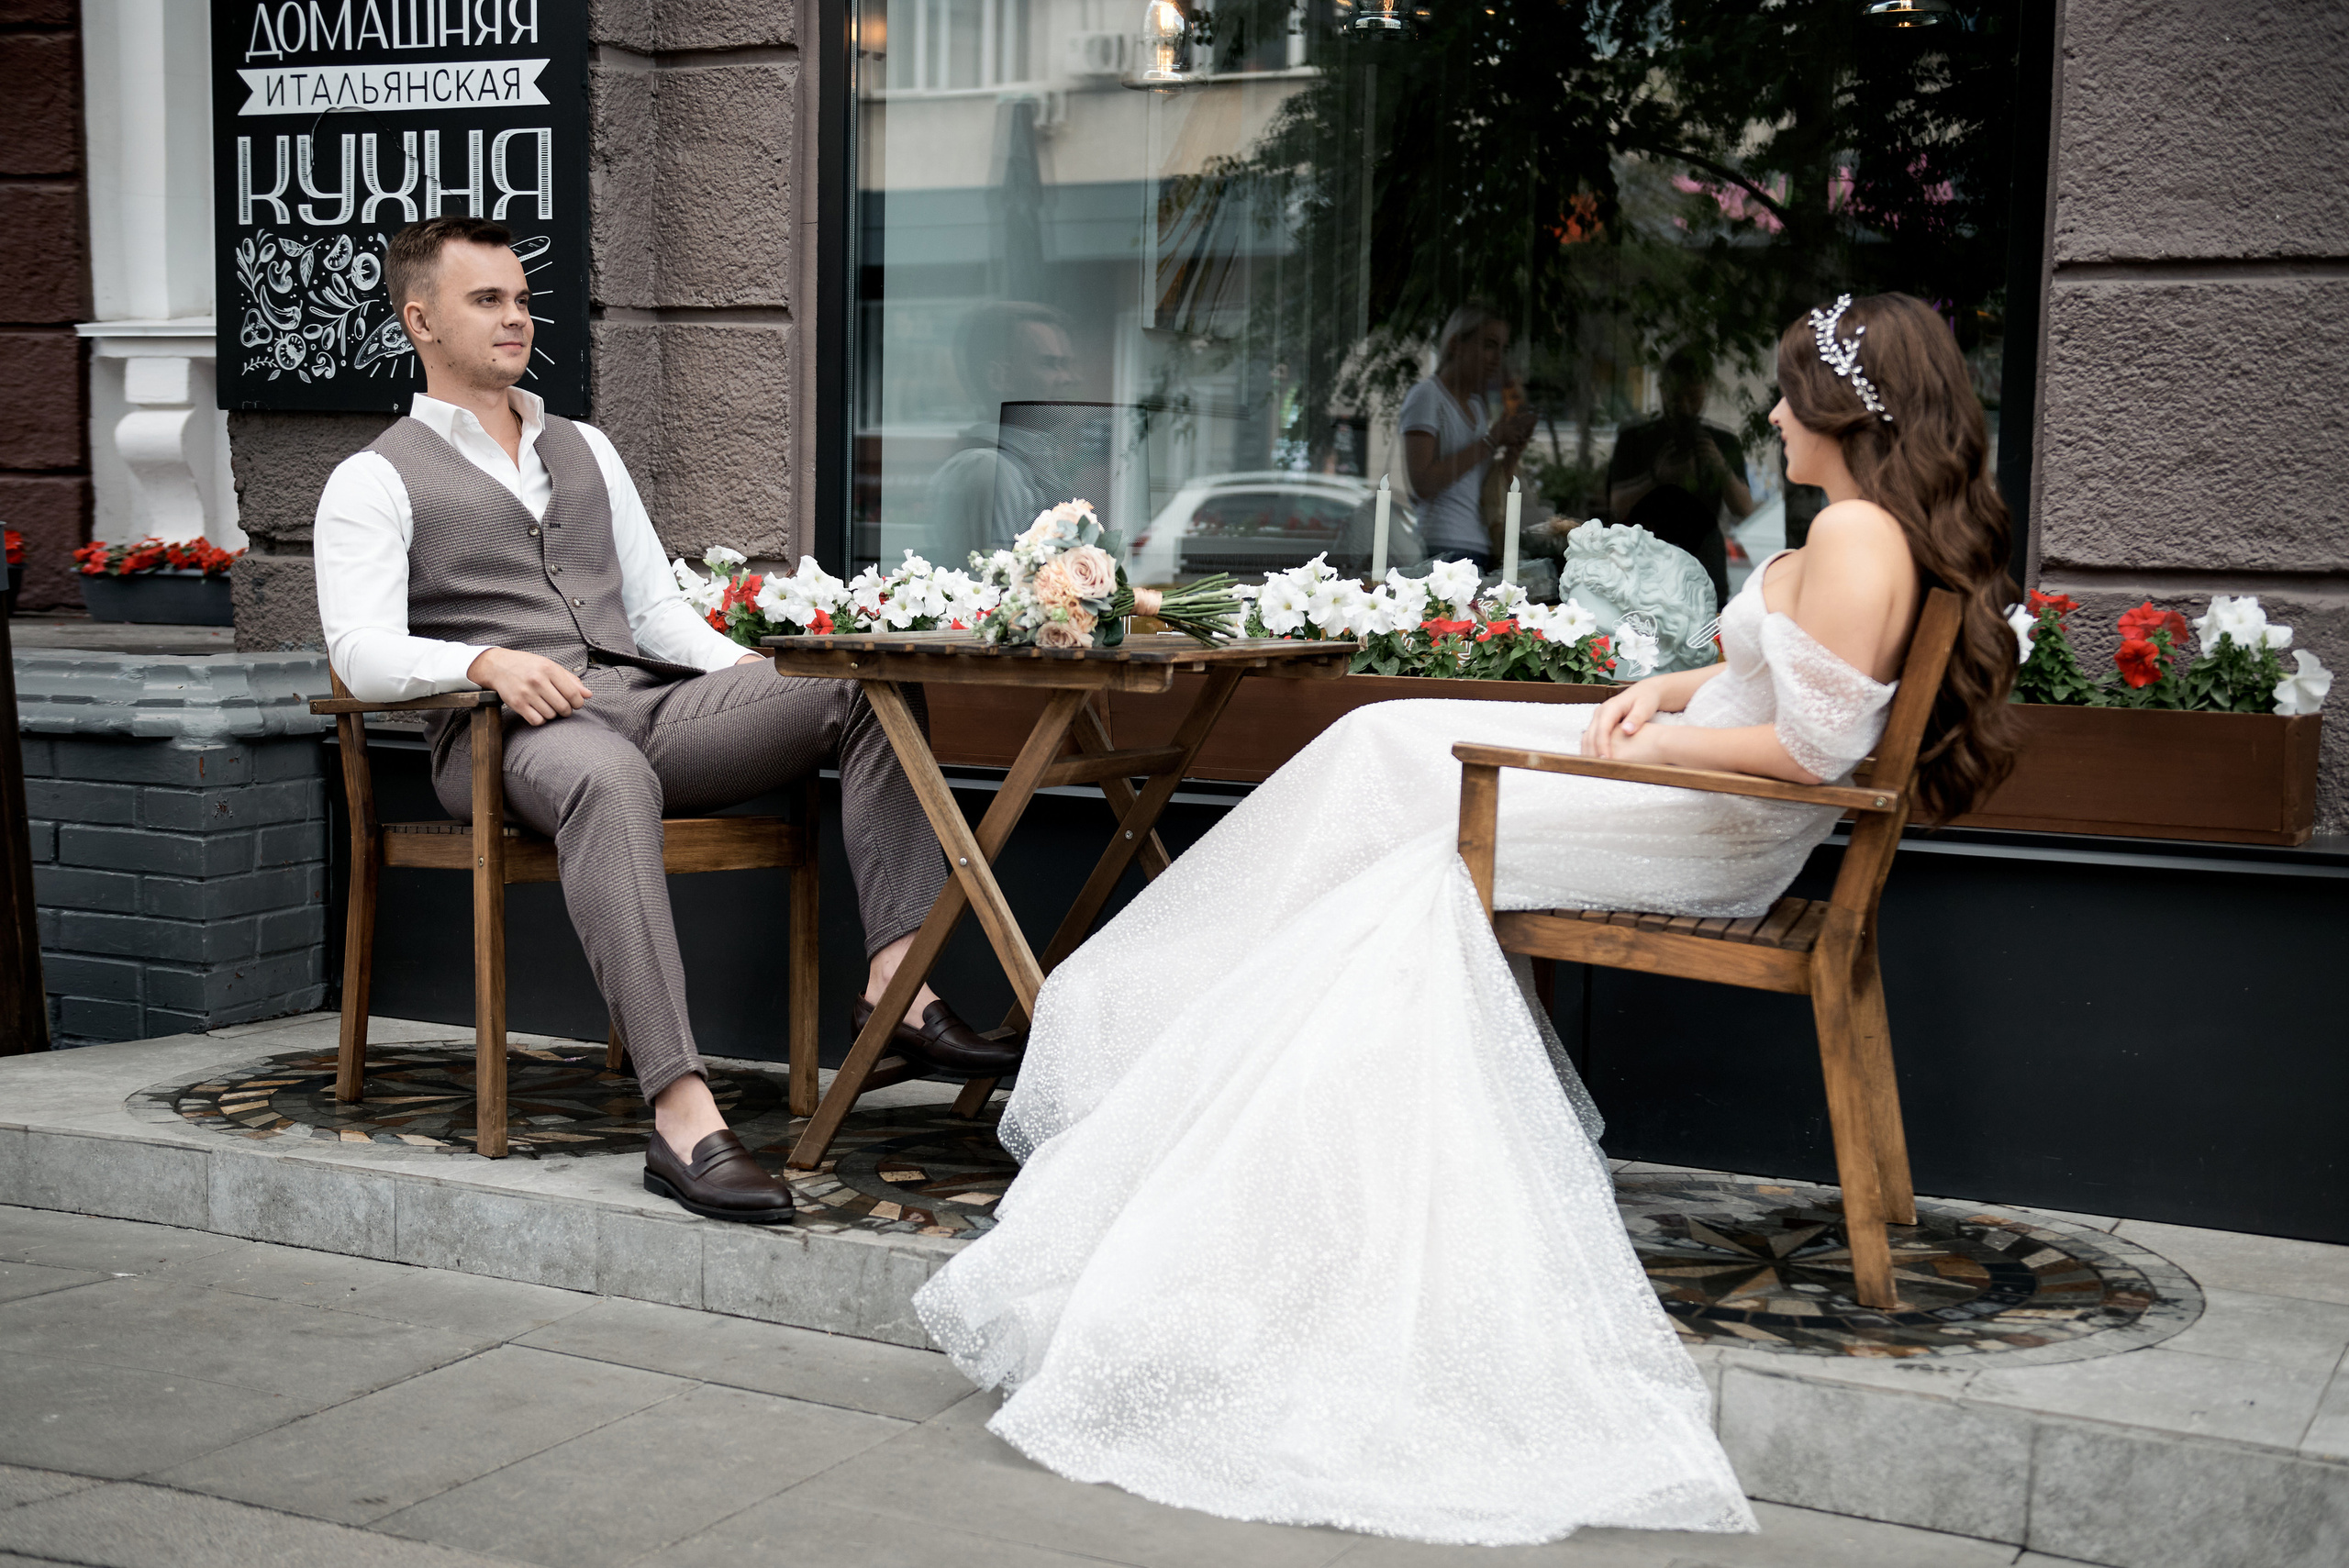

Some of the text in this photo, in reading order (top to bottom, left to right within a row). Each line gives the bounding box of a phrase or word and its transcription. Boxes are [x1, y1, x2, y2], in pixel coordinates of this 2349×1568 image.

[245, 0, 539, 63] ДОМАШНЯЯ
[266, 67, 521, 106] ИТАЛЬЯНСКАЯ
[237, 128, 553, 226] КУХНЯ
